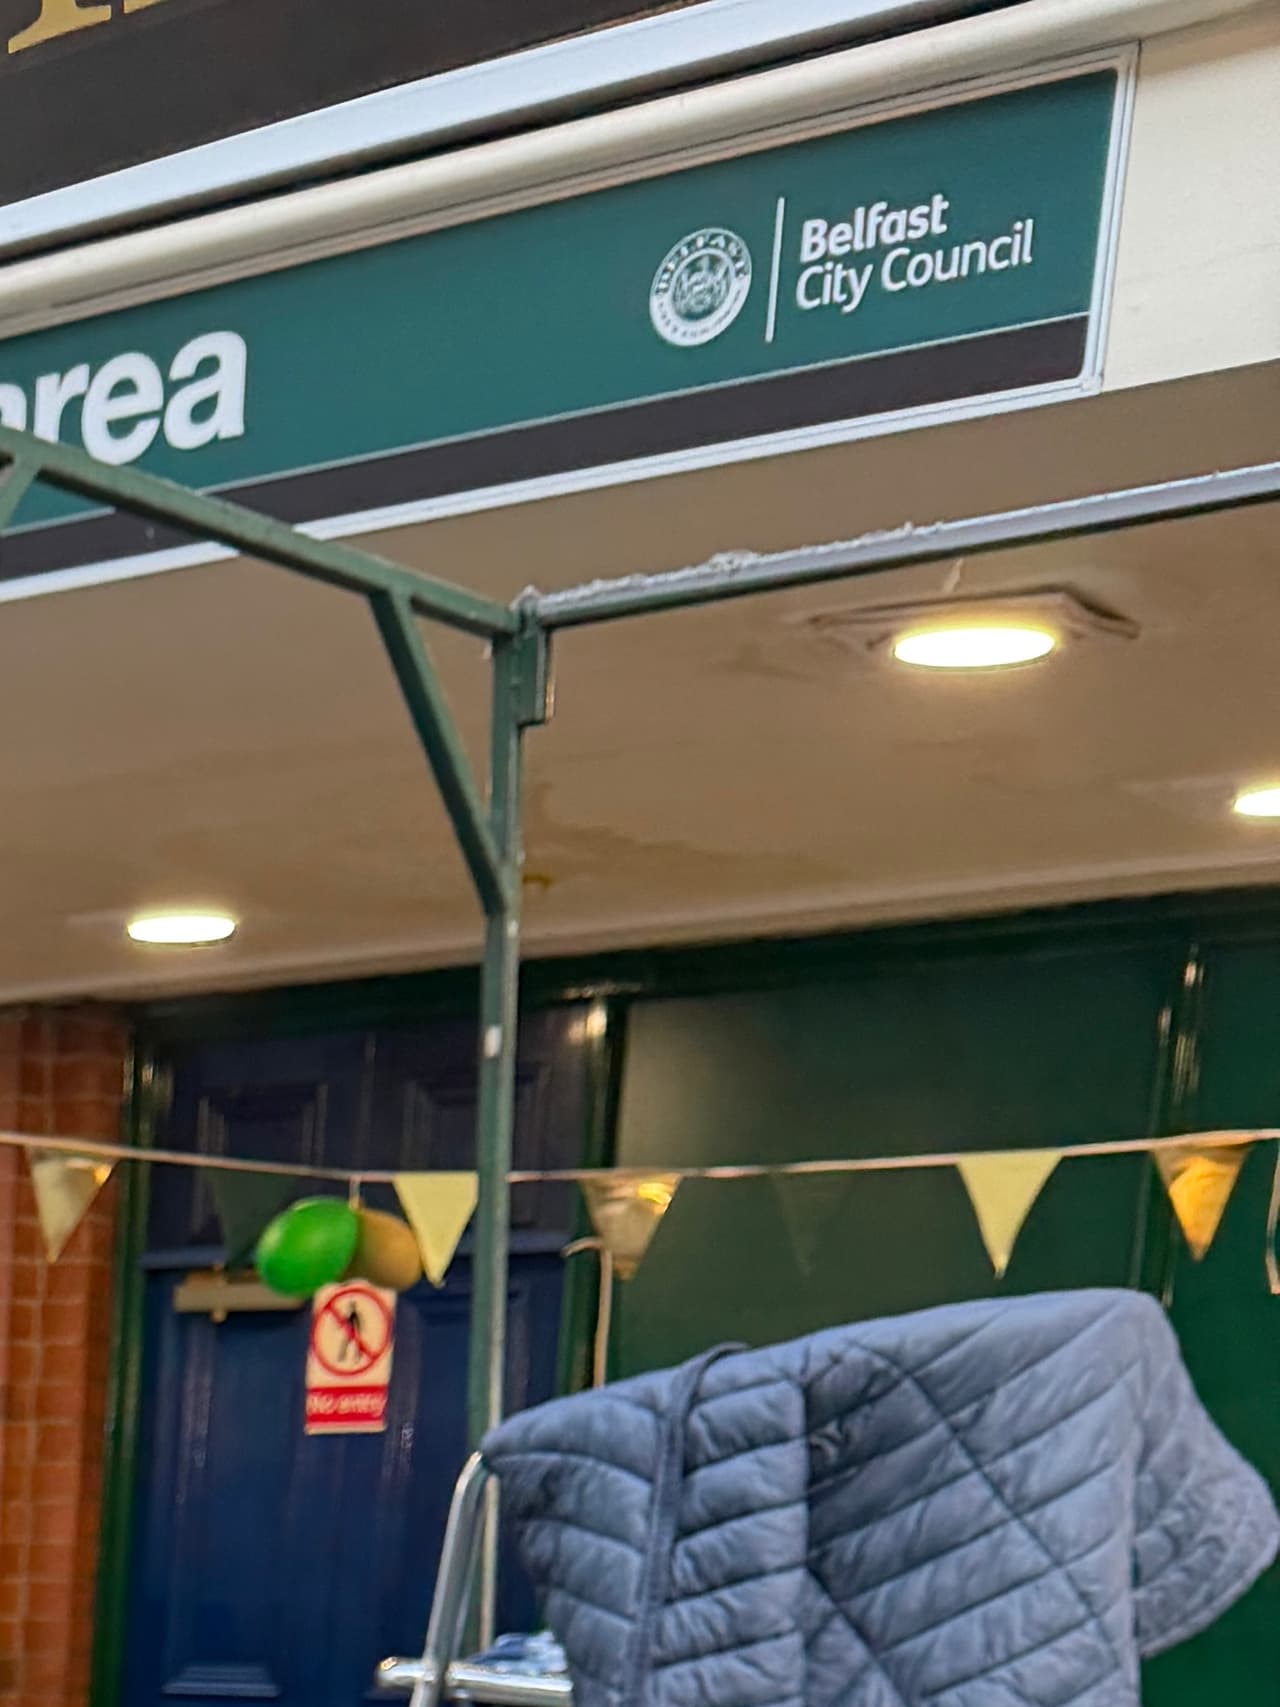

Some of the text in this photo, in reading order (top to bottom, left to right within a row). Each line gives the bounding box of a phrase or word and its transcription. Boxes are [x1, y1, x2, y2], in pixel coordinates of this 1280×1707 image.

[796, 218, 1033, 314] City Council
[800, 193, 949, 263] Belfast
